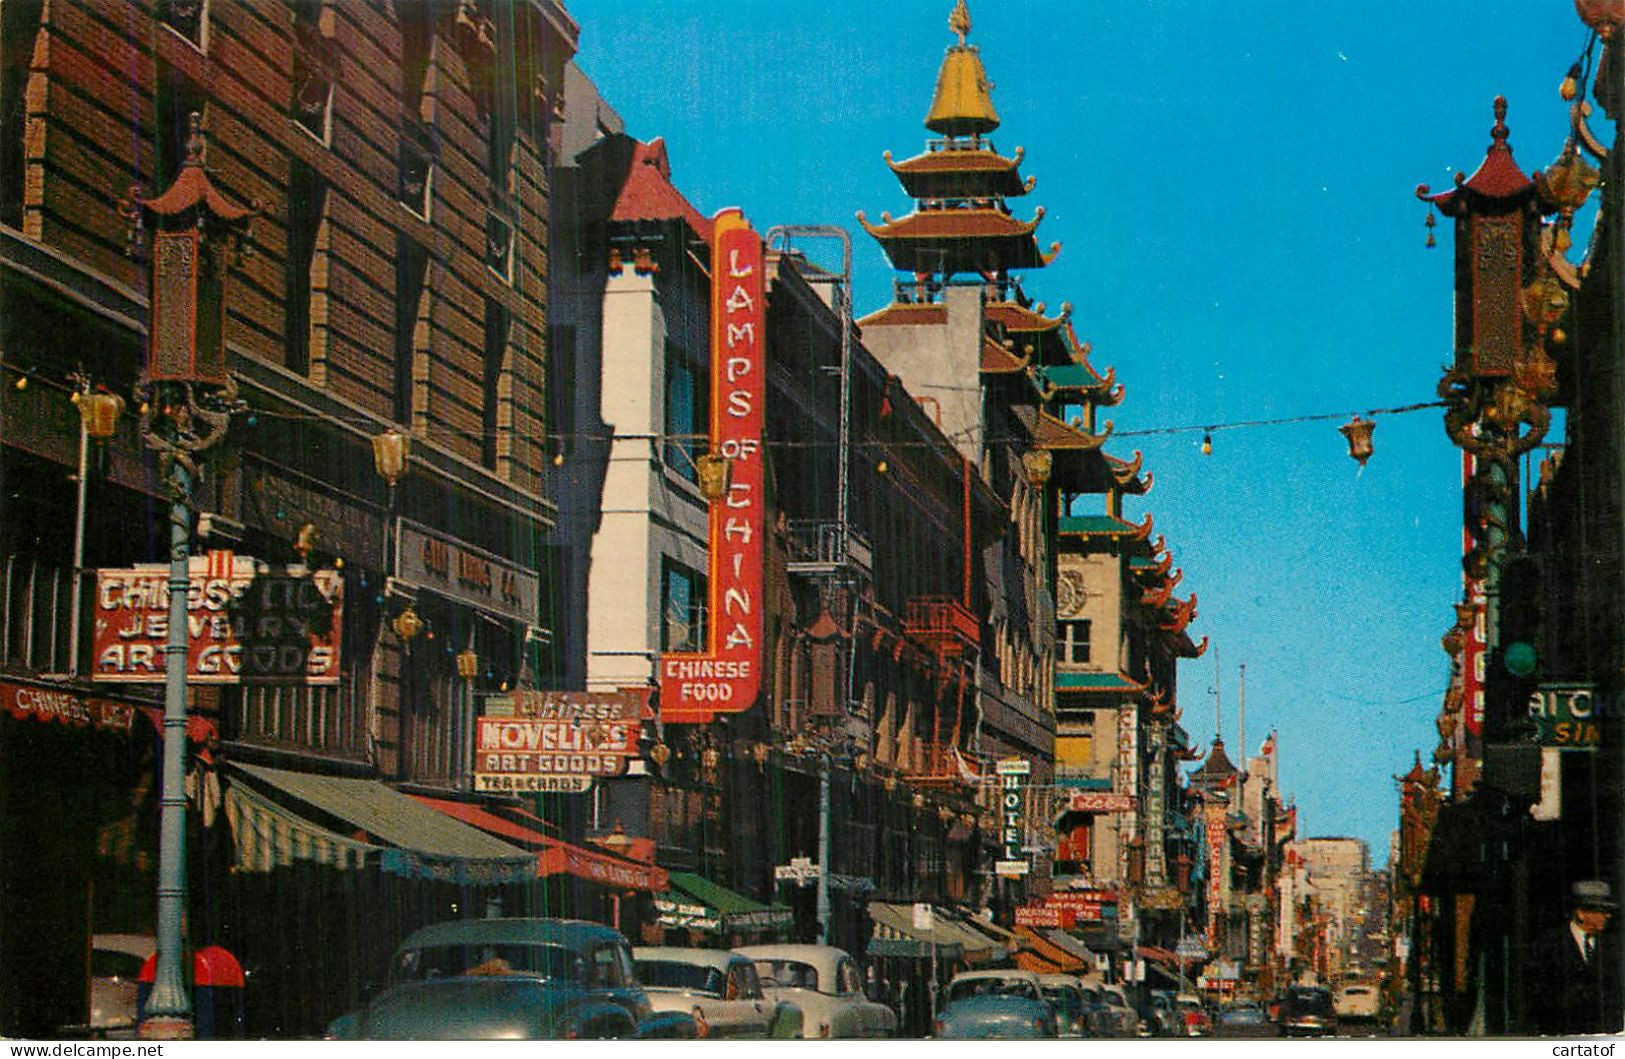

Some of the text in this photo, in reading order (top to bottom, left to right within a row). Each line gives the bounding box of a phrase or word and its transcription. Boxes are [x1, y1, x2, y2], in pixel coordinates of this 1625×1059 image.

[721, 249, 759, 650] LAMPS OF CHINA
[101, 579, 252, 611] CHINESE
[198, 644, 333, 674] GOODS
[666, 660, 750, 679] CHINESE
[681, 682, 732, 701] FOOD
[486, 754, 616, 773] ART GOODS
[1005, 776, 1019, 860] HOTEL
